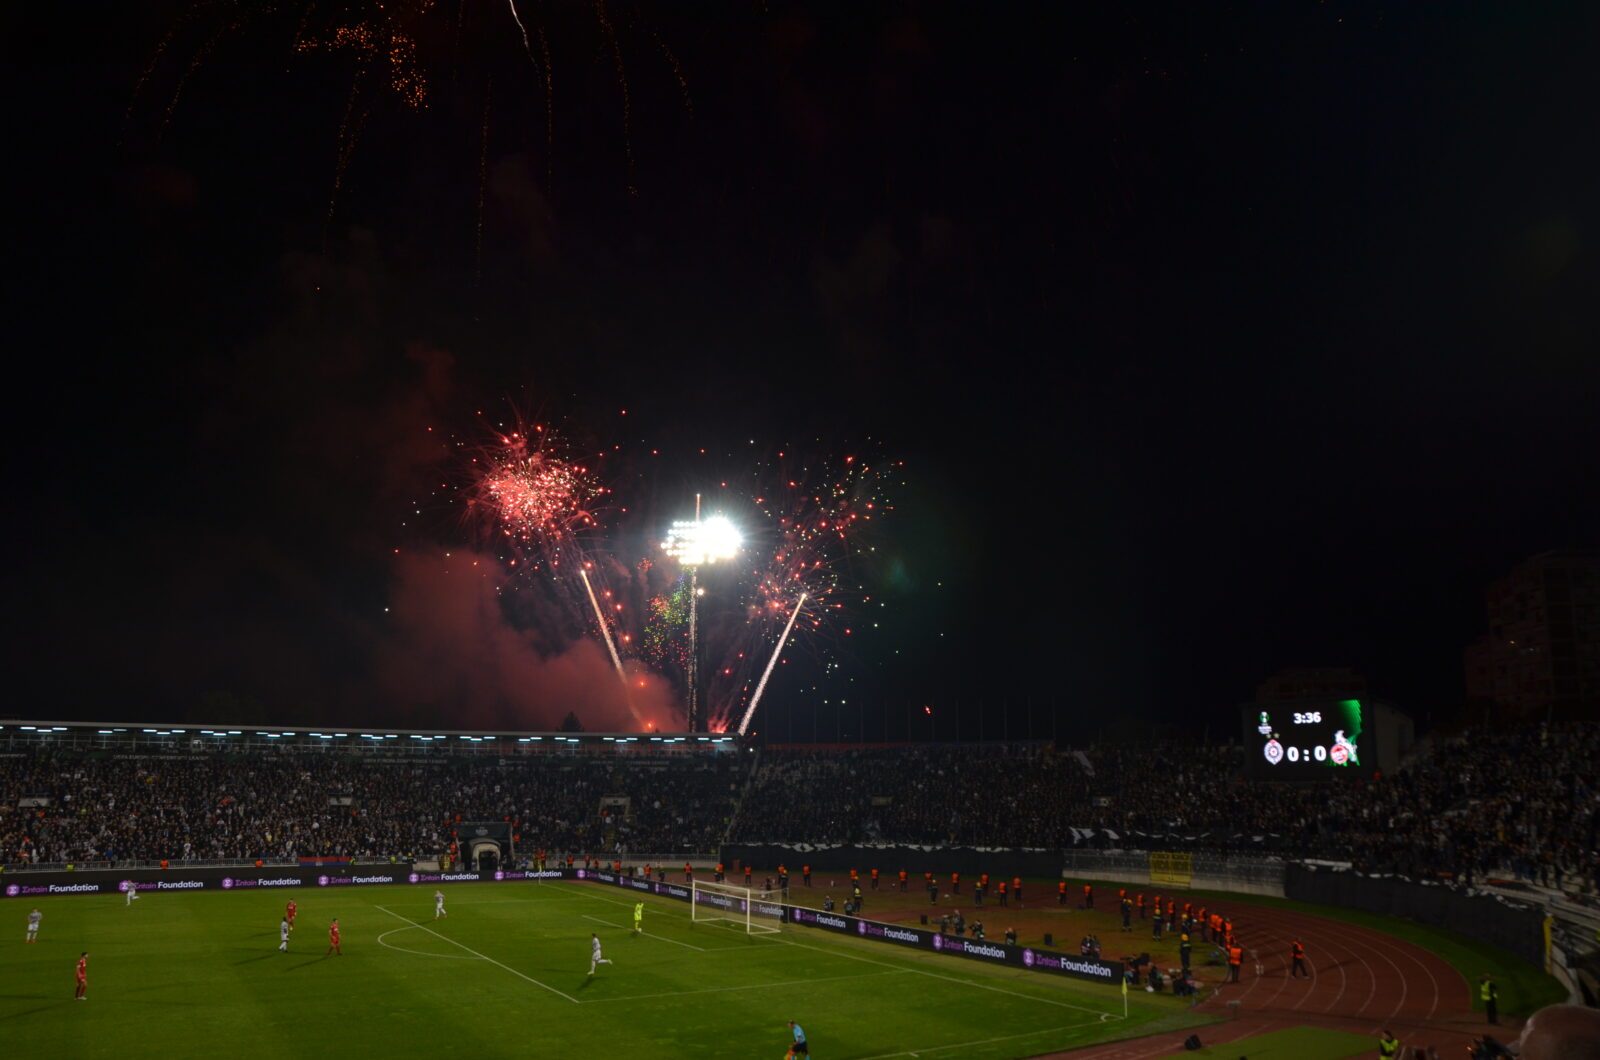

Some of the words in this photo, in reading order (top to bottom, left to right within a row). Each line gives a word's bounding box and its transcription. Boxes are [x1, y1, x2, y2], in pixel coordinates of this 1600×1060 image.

[1293, 711, 1321, 724] 3:36
[352, 875, 392, 883] Foundation
[440, 872, 479, 881] Foundation
[525, 870, 562, 878] Foundation
[157, 880, 203, 889] Foundation
[258, 877, 301, 886] Foundation
[49, 883, 98, 893] Foundation
[816, 914, 846, 928] Foundation
[884, 927, 919, 943] Foundation
[964, 941, 1005, 959] Foundation
[1060, 957, 1111, 977] Foundation
